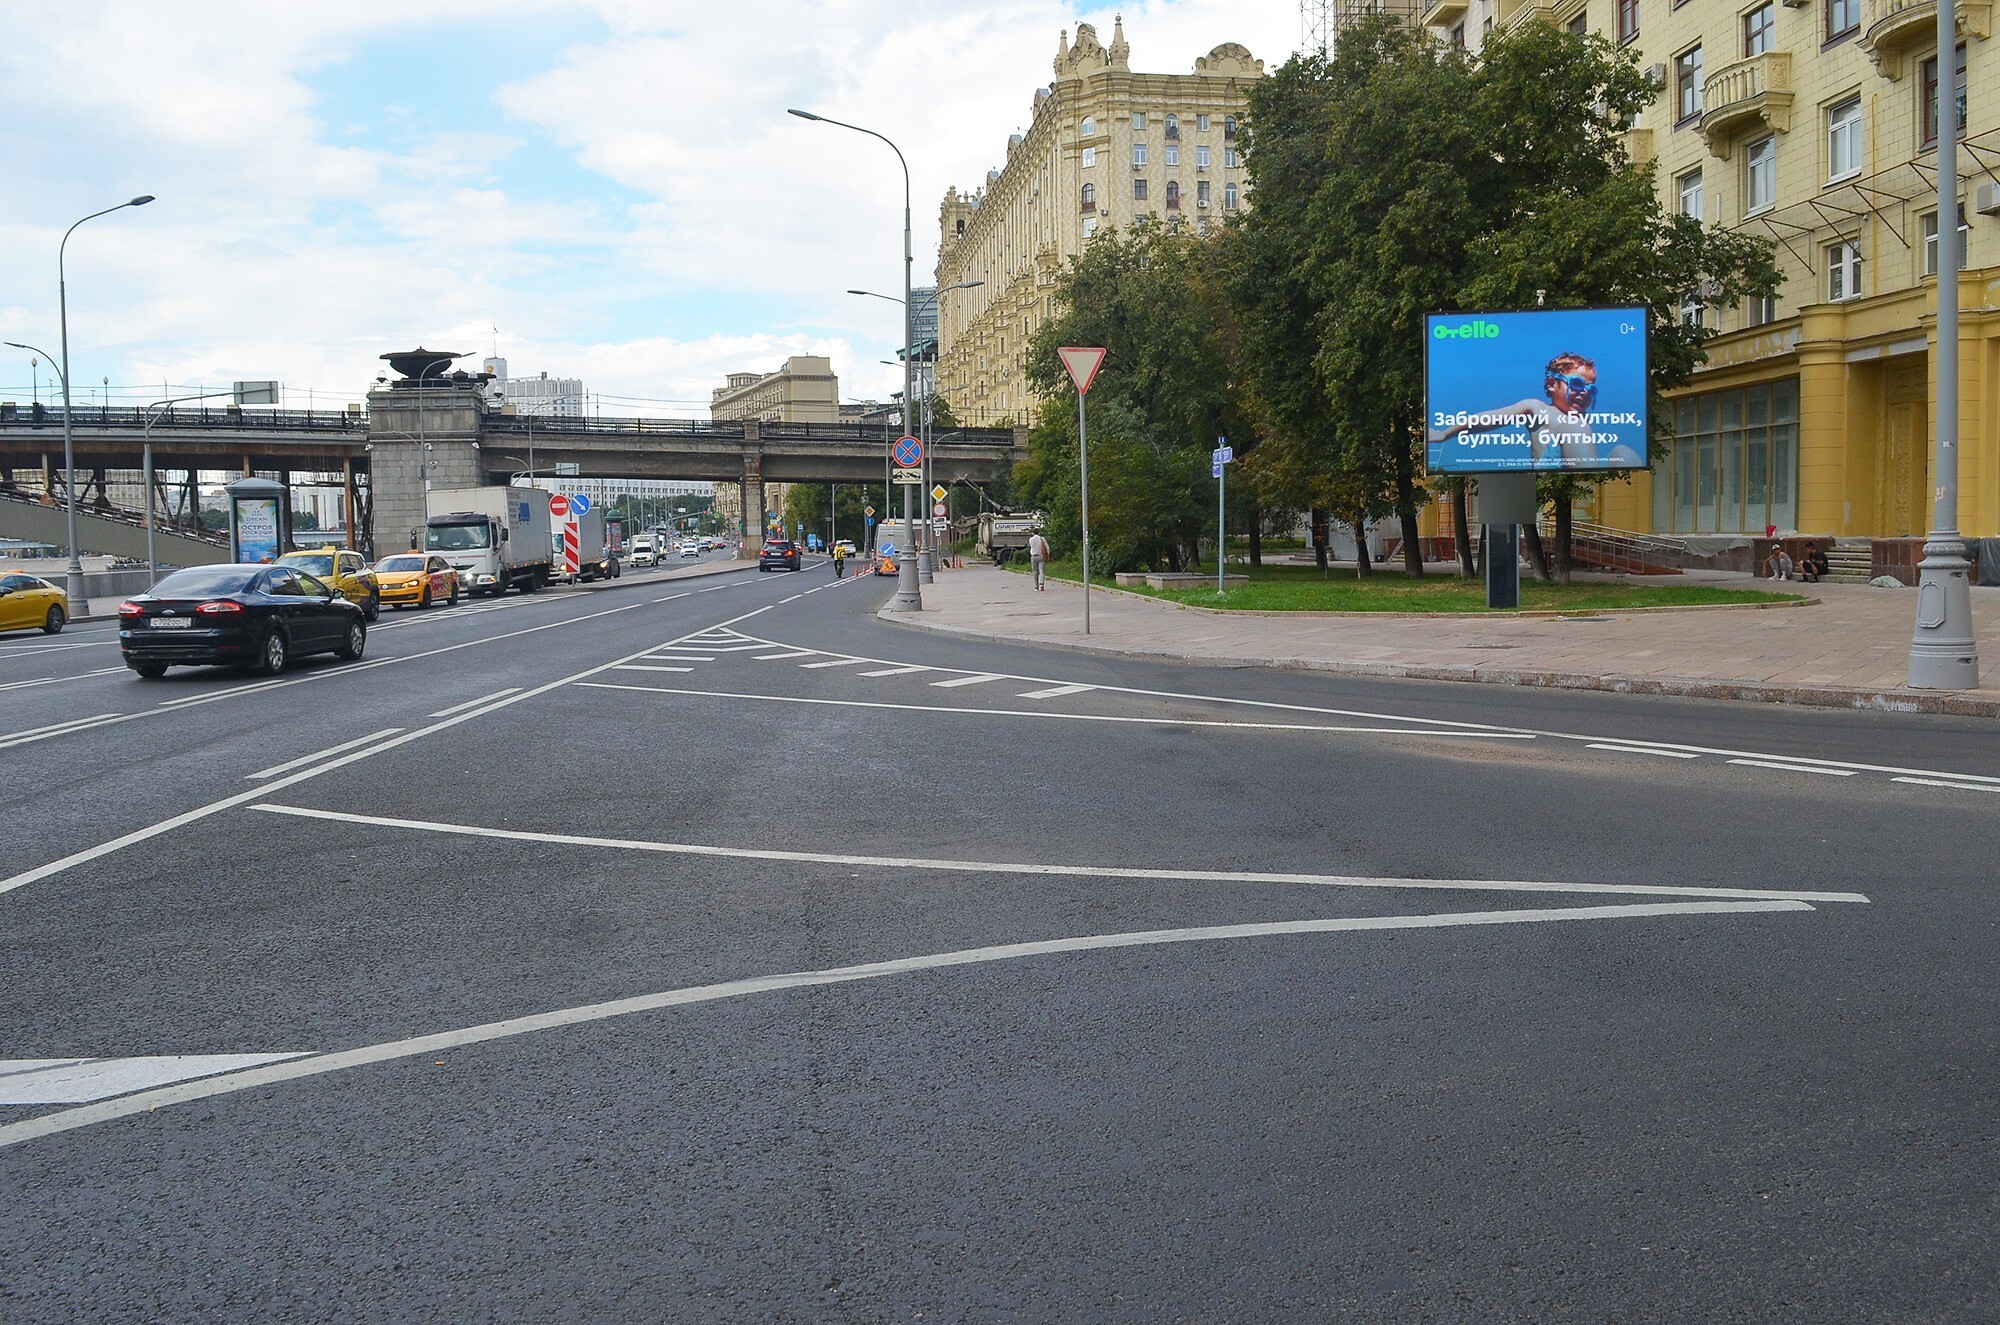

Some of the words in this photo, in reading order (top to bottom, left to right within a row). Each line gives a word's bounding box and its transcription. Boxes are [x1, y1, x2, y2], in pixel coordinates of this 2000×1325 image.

[1620, 323, 1636, 335] 0+
[1434, 410, 1549, 429] Забронируй
[1556, 410, 1642, 428] «Бултых,
[1457, 429, 1532, 448] бултых,
[1538, 429, 1619, 448] бултых»
